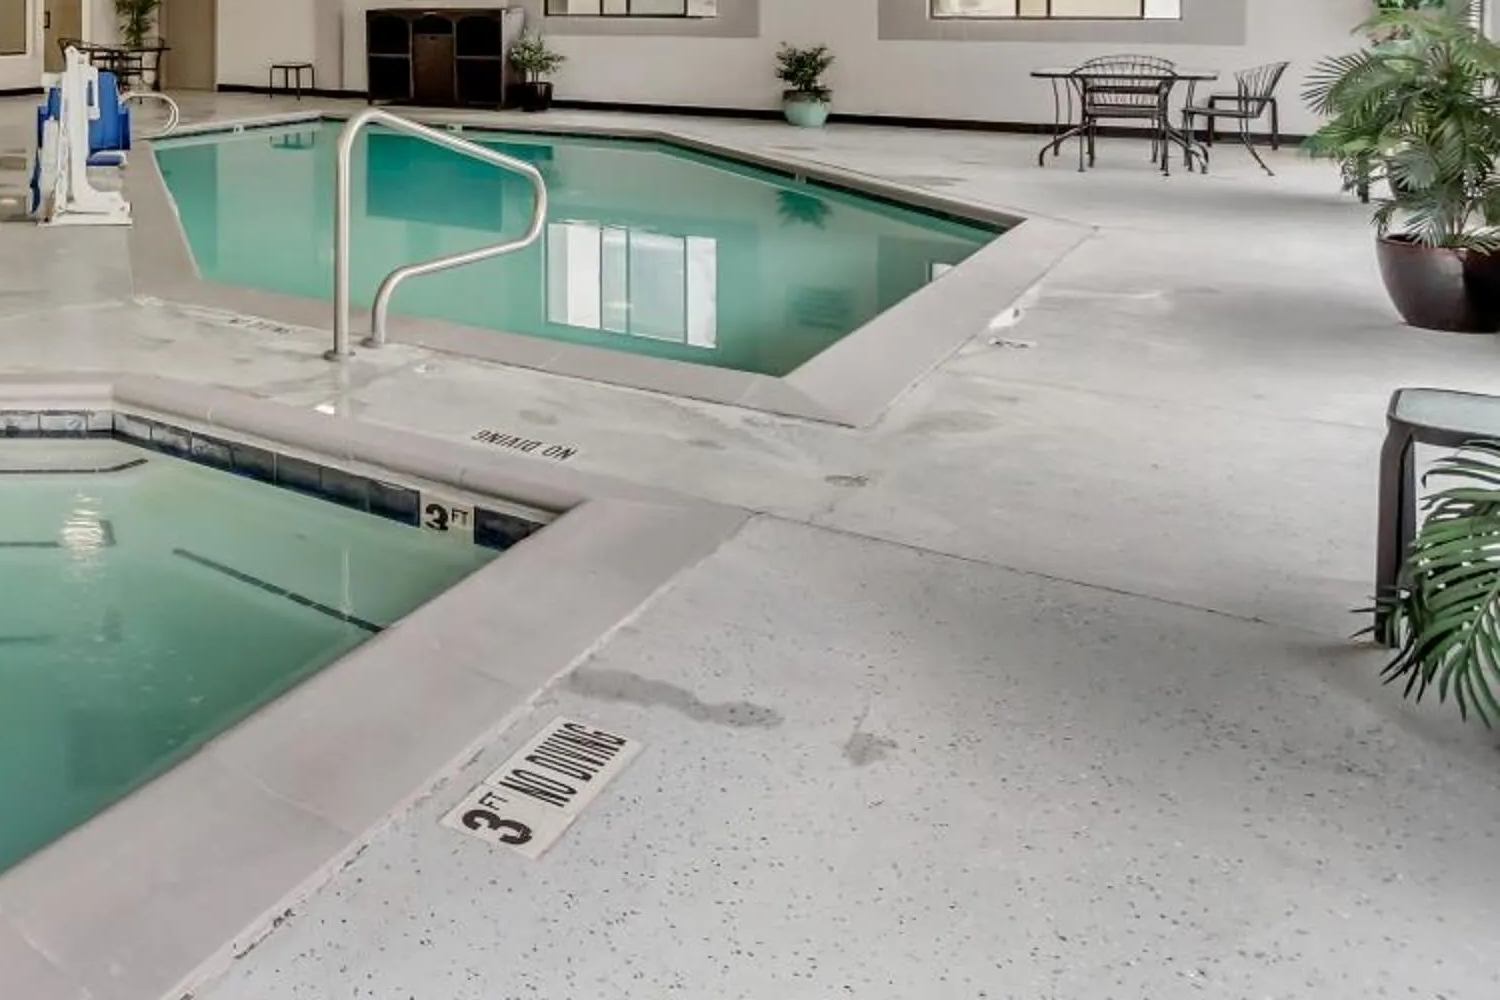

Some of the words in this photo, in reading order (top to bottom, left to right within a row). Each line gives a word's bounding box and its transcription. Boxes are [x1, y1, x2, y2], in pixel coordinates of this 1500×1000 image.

[471, 429, 543, 453] DIVING
[542, 445, 579, 461] NO
[425, 503, 449, 531] 3
[451, 507, 469, 526] FT
[524, 722, 628, 782] DIVING
[478, 791, 509, 811] FT
[499, 768, 578, 808] NO
[462, 809, 533, 845] 3
